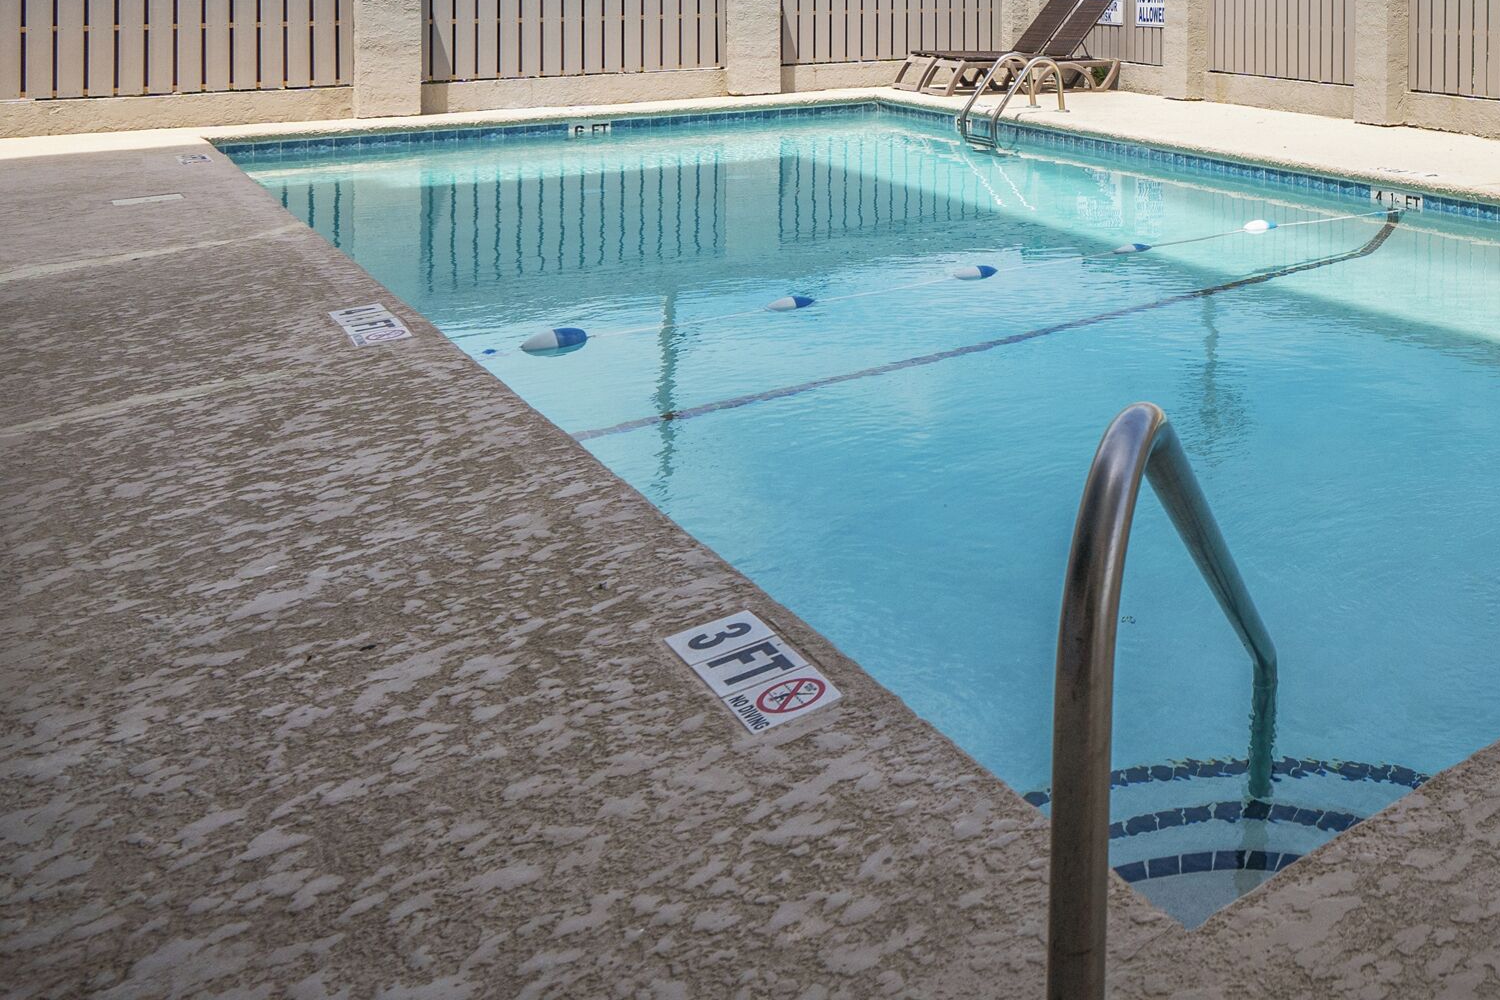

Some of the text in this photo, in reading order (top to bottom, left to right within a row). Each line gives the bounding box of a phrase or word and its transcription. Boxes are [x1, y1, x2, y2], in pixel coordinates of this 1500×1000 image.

[592, 123, 609, 135] FT
[1405, 194, 1420, 208] FT
[351, 319, 396, 333] FT
[687, 622, 796, 686] 3 FT
[728, 694, 770, 730] NO DIVING
